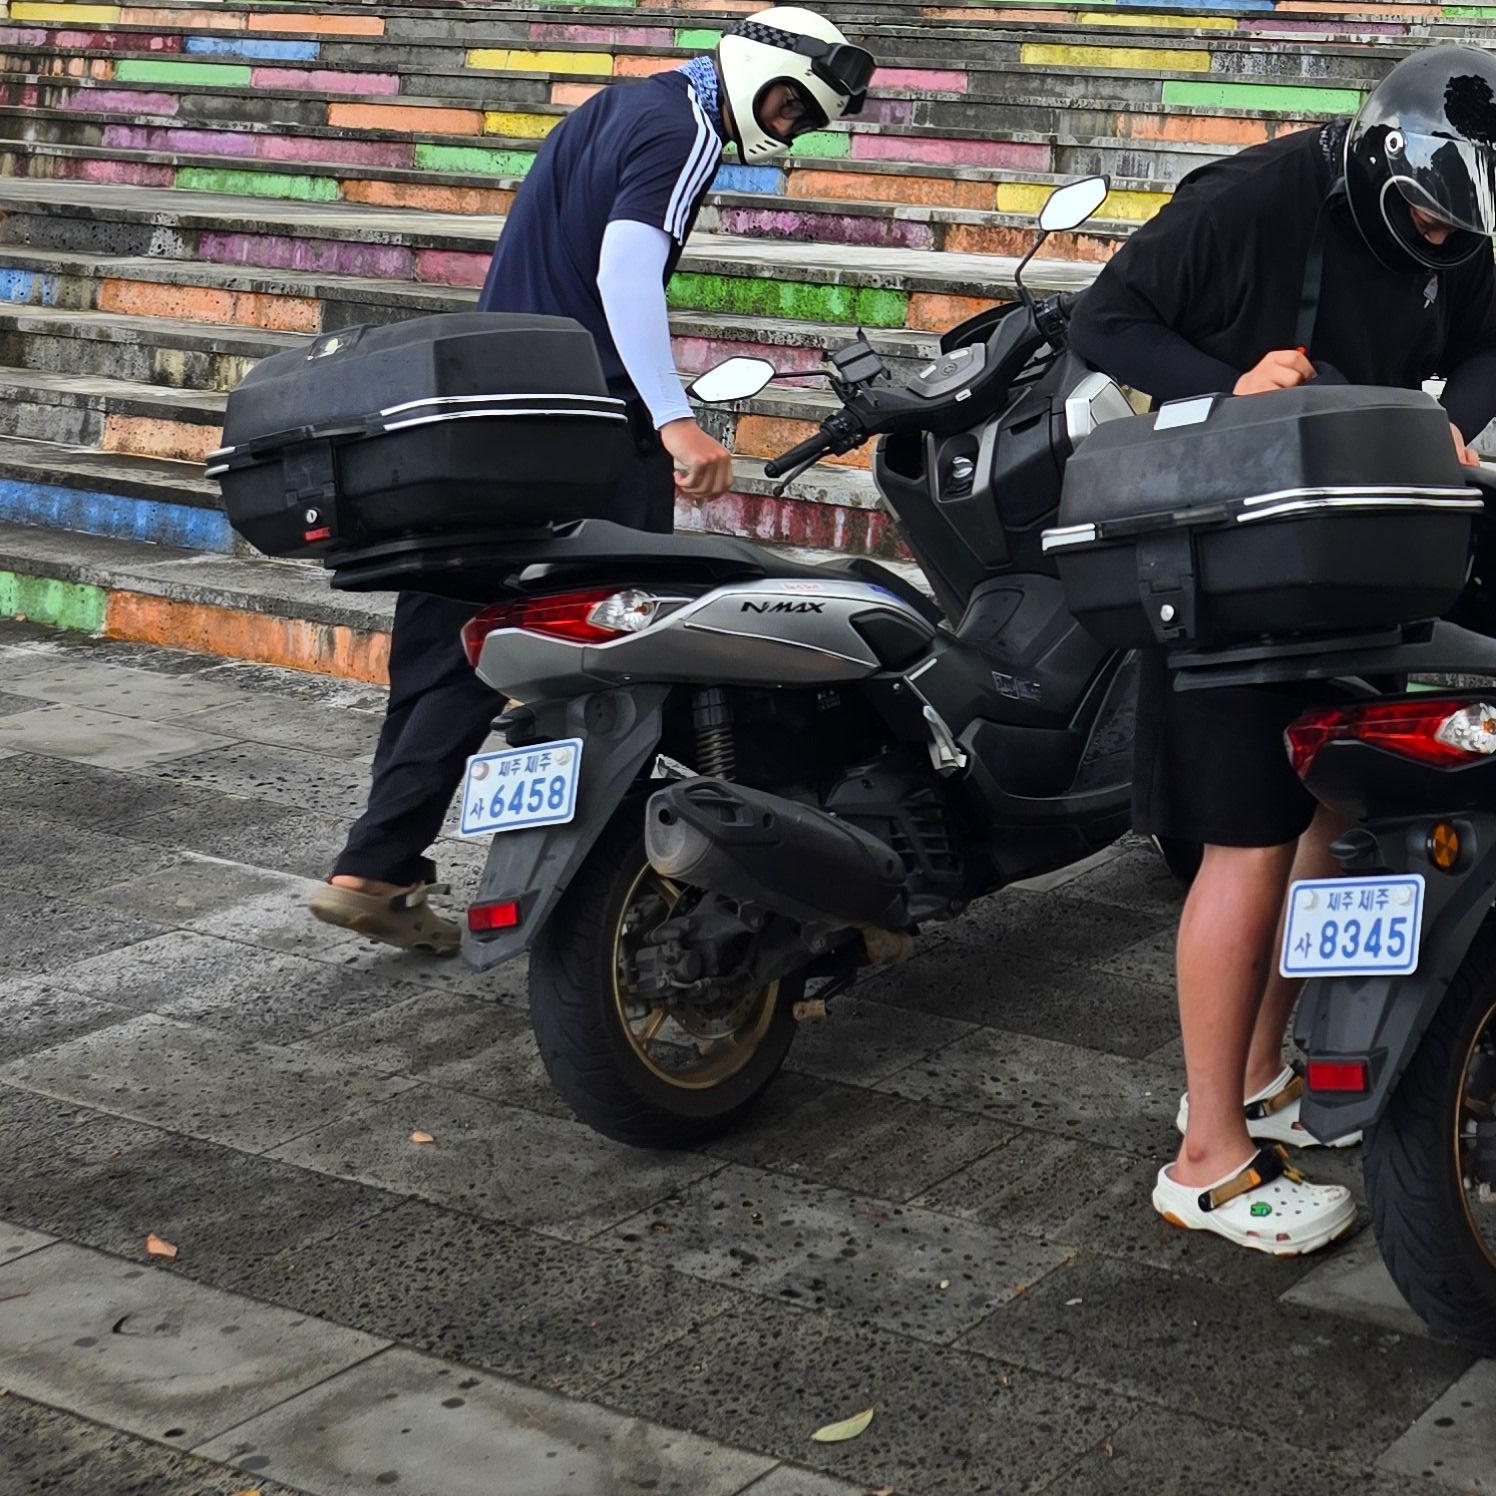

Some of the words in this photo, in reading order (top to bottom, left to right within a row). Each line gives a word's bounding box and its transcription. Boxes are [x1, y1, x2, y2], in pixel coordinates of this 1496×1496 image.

[740, 600, 827, 614] NMAX
[498, 757, 522, 777] 제주
[525, 752, 552, 773] 제주
[469, 797, 485, 820] 사
[489, 775, 566, 819] 6458
[1327, 890, 1355, 912] 제주
[1358, 888, 1389, 912] 제주
[1294, 932, 1313, 959] 사
[1319, 916, 1408, 960] 8345
